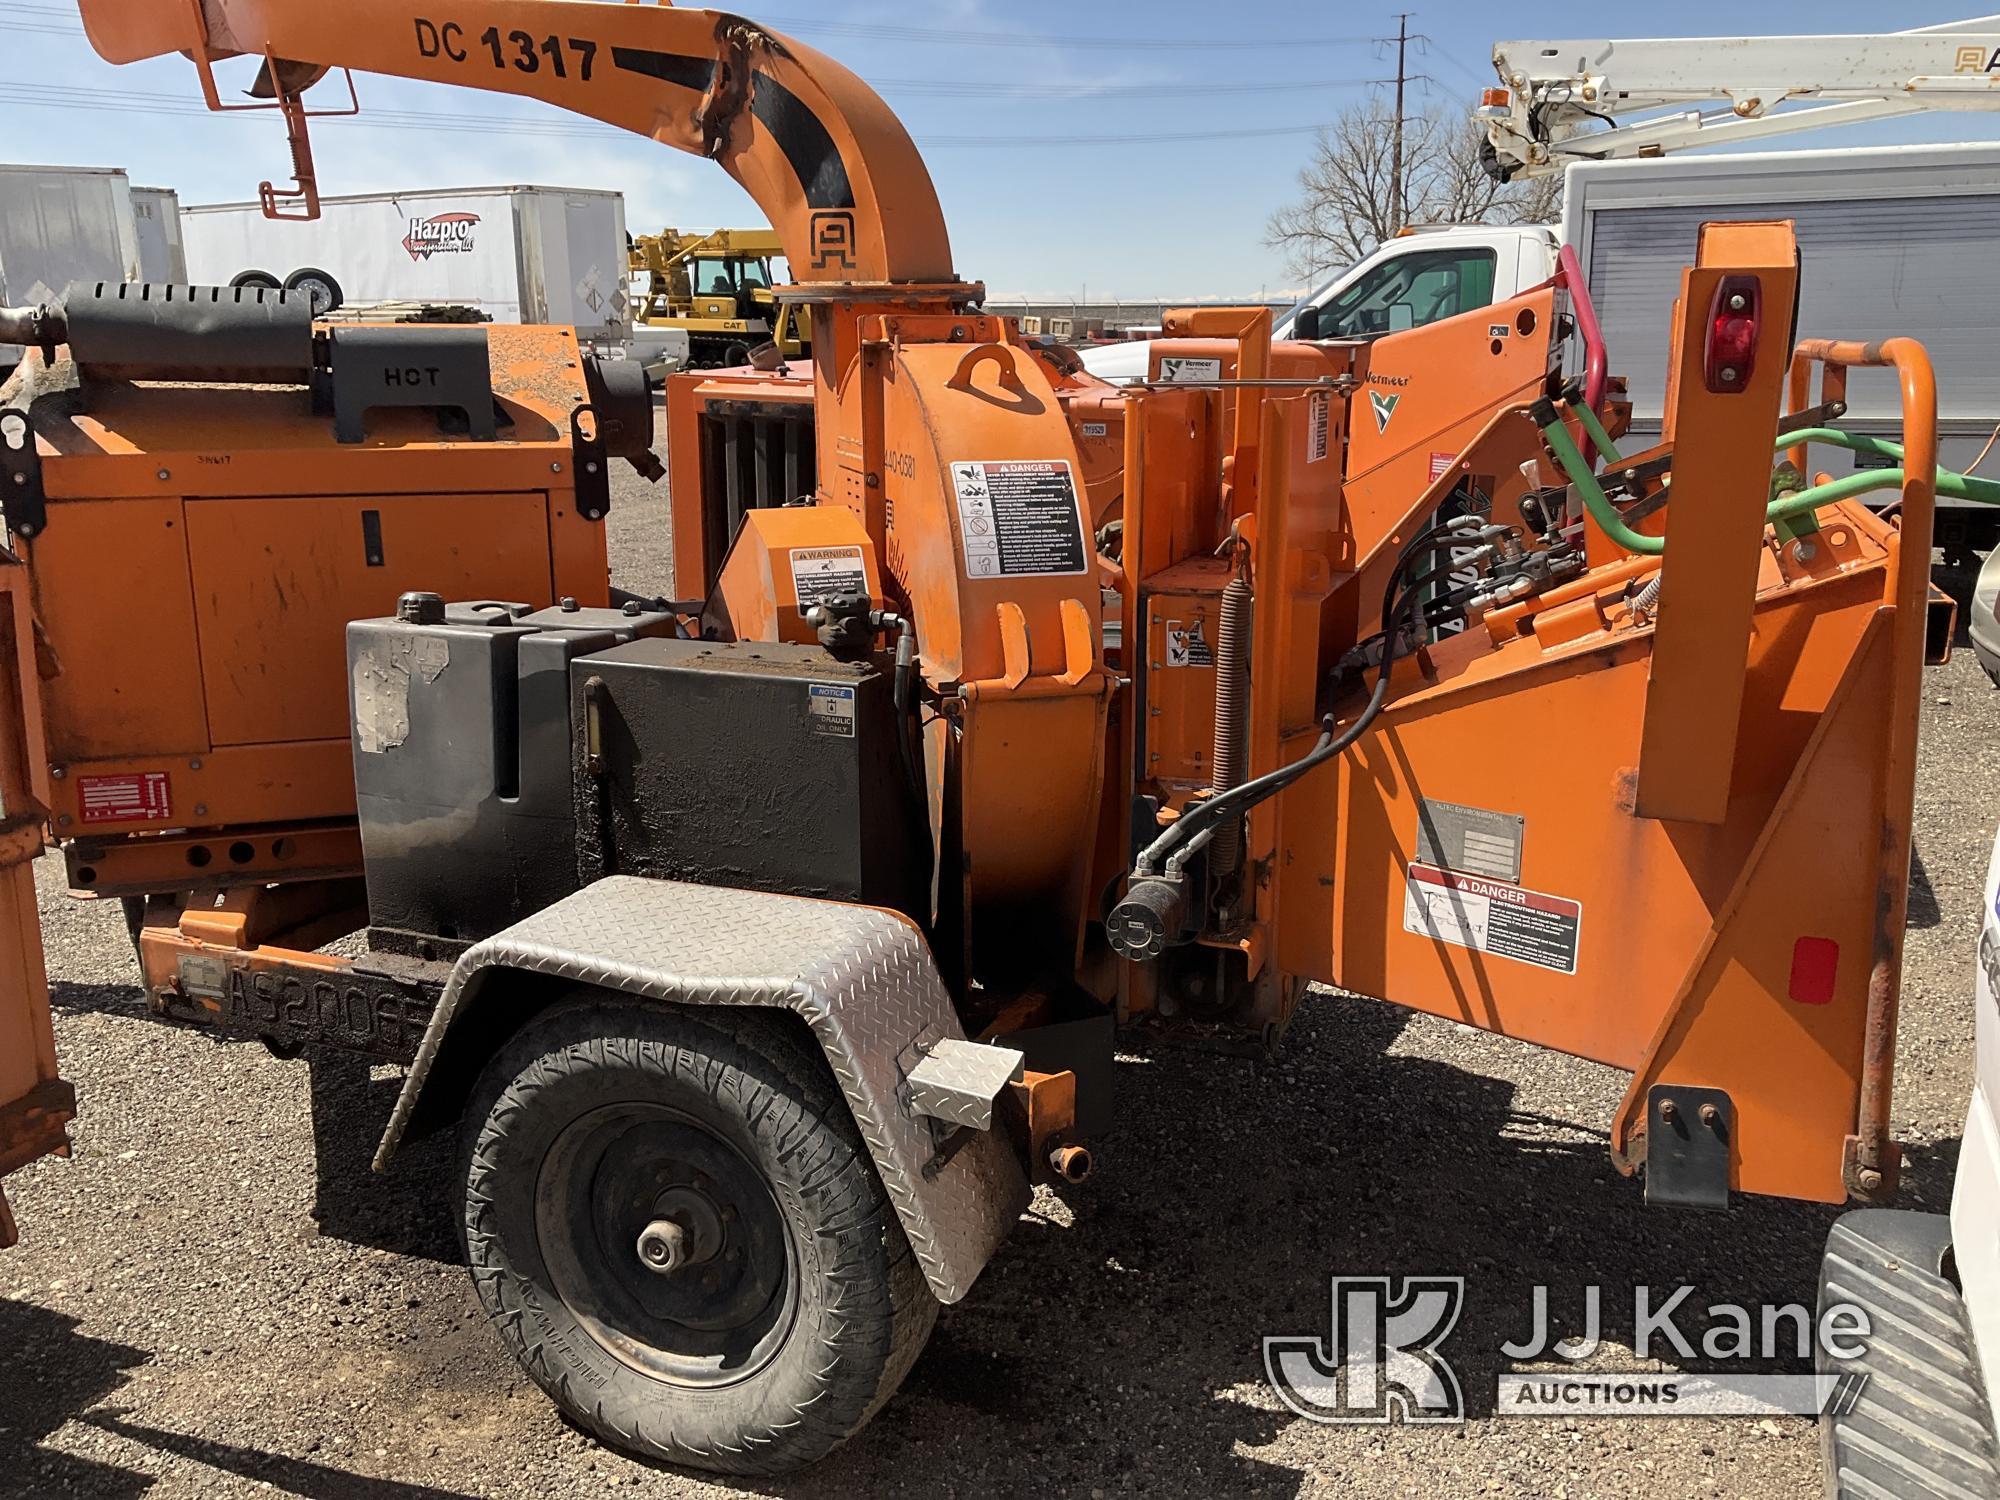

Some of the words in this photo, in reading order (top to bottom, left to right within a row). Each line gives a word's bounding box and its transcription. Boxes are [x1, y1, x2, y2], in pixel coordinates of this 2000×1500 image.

[414, 18, 466, 62] DC
[481, 27, 597, 81] 1317
[410, 218, 469, 242] Hazpro
[385, 367, 440, 386] HOT
[1365, 371, 1409, 386] Vermeer
[1009, 464, 1053, 473] DANGER
[808, 550, 852, 560] WARNING
[819, 688, 845, 697] NOTICE
[829, 725, 848, 733] ONLY
[1471, 881, 1526, 904] DANGER
